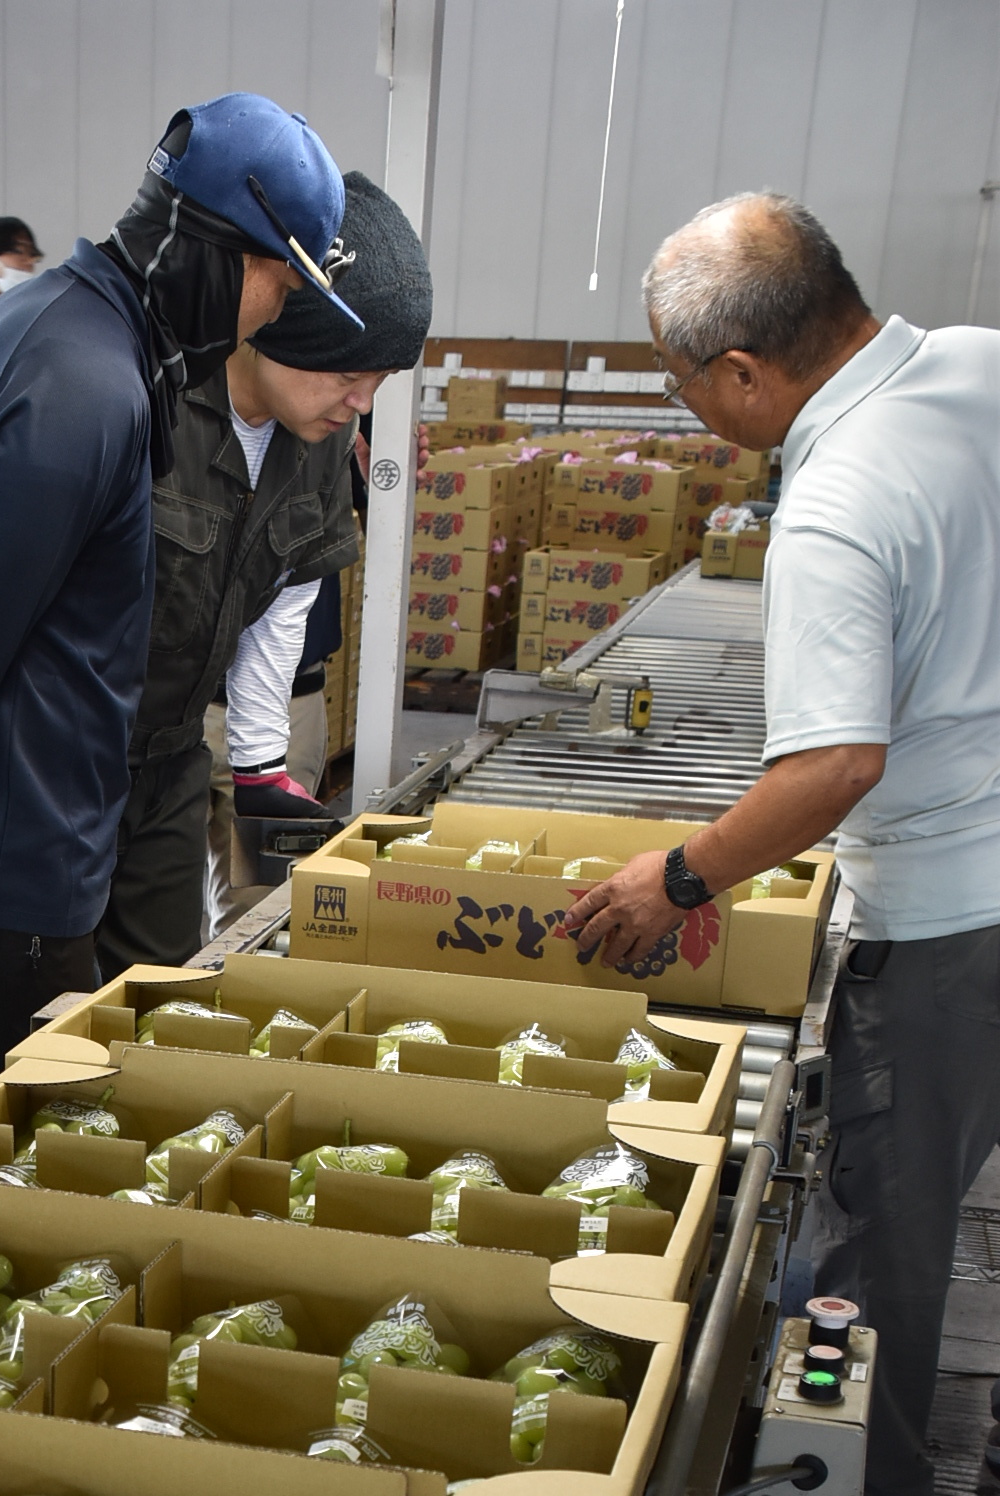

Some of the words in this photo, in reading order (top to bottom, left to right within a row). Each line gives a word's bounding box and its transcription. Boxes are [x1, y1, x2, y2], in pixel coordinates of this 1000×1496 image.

[374, 462, 398, 488] 秀
[316, 887, 345, 904] 信州
[377, 880, 451, 907] 長野県の
[302, 922, 358, 937] JA全農長野
